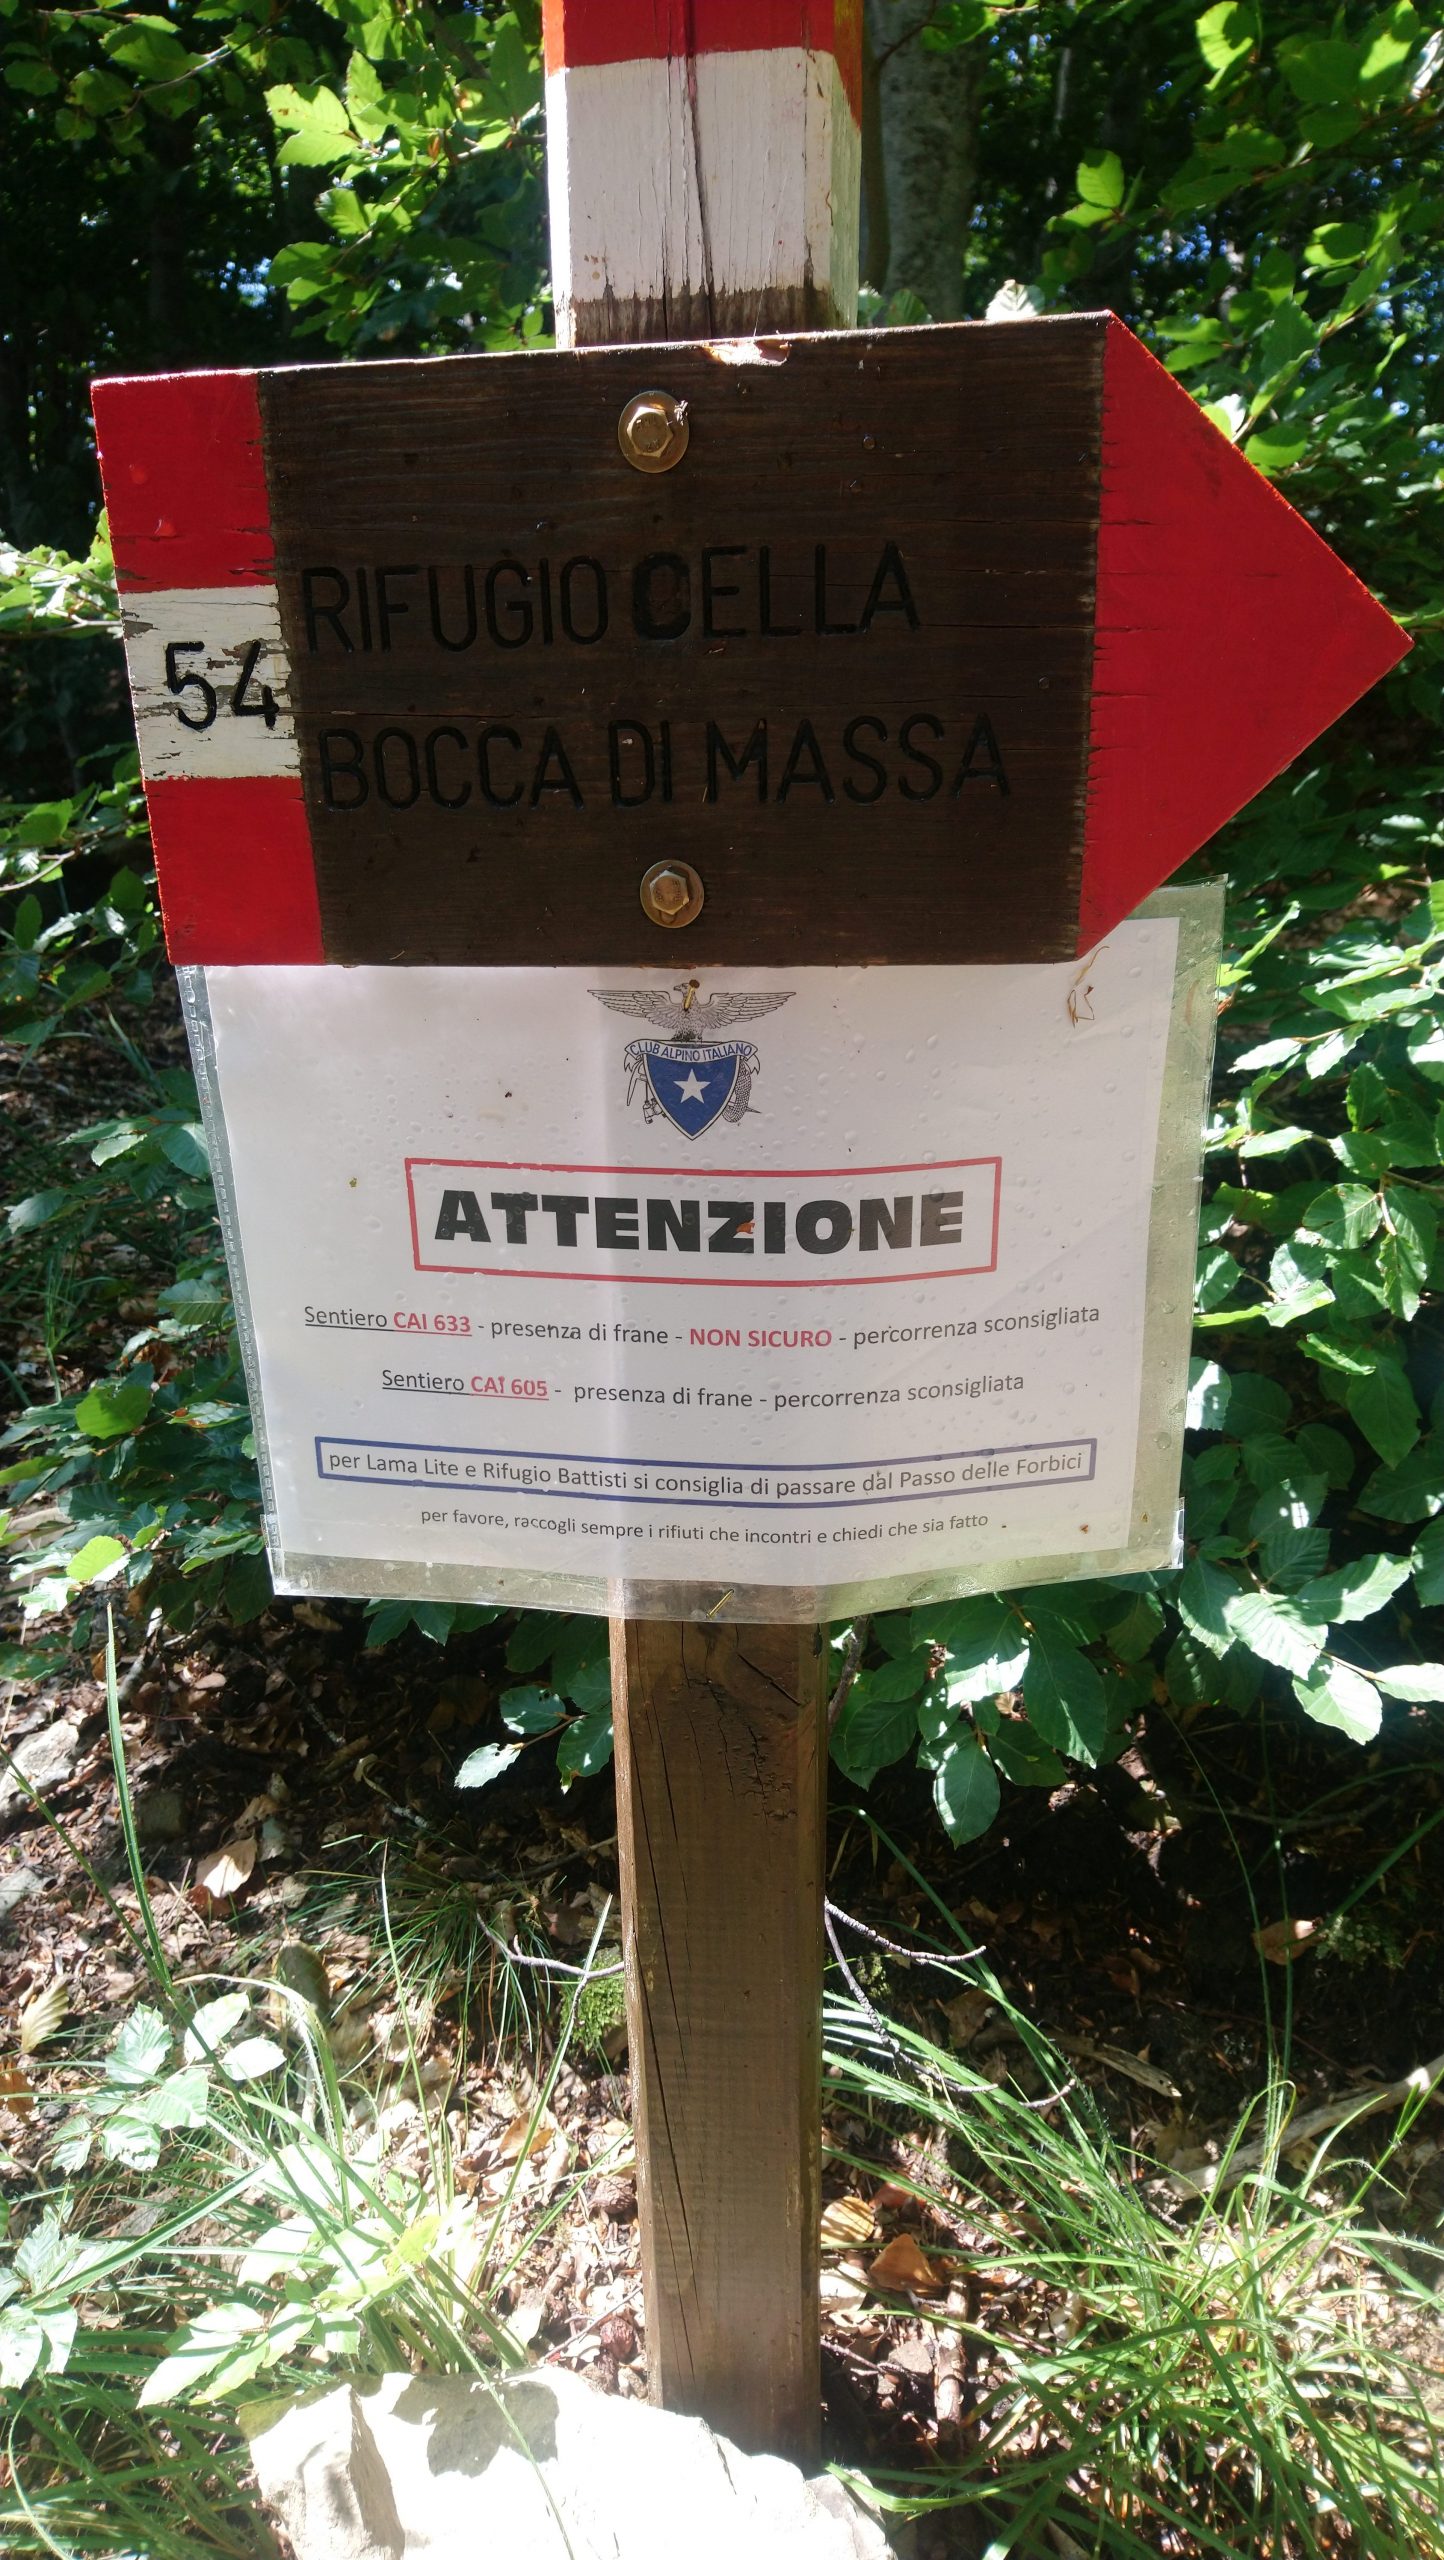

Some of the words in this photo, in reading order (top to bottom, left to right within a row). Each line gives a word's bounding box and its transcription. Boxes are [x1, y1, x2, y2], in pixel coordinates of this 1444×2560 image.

[303, 556, 609, 653] RIFUGIO
[633, 541, 920, 640] CELLA
[166, 641, 279, 731] 54
[320, 726, 584, 811] BOCCA
[608, 719, 673, 808] DI
[707, 712, 1010, 804] MASSA
[629, 1041, 660, 1056] CLUB
[661, 1046, 700, 1061] ALPINO
[703, 1042, 752, 1061] ITALIANO
[435, 1190, 964, 1254] ATTENZIONE
[305, 1306, 387, 1328] Sentiero
[393, 1311, 427, 1330] CAI
[433, 1314, 471, 1333] 633
[491, 1320, 582, 1340] presenza
[589, 1322, 607, 1342] di
[614, 1324, 668, 1344] frane
[690, 1328, 741, 1347] NON
[748, 1328, 832, 1348] SICURO
[854, 1320, 977, 1350] percorrenza
[984, 1306, 1100, 1333] sconsigliata
[382, 1370, 465, 1393] Sentiero
[471, 1376, 505, 1394] CAI
[511, 1378, 548, 1397] 605
[574, 1385, 665, 1404] presenza
[673, 1387, 690, 1405] di
[697, 1388, 752, 1408] frane
[774, 1390, 900, 1412] percorrenza
[907, 1374, 1024, 1399] sconsigliata
[329, 1452, 360, 1471] per
[367, 1454, 417, 1473] Lama
[425, 1458, 459, 1476] Lite
[465, 1464, 476, 1478] e
[484, 1461, 551, 1485] Rifugio
[558, 1467, 626, 1488] Battisti
[634, 1472, 648, 1490] si
[655, 1476, 743, 1497] consiglia
[750, 1477, 769, 1496] di
[776, 1478, 856, 1499] passare
[862, 1473, 892, 1492] dal
[900, 1468, 955, 1488] Passo
[962, 1462, 1009, 1482] delle
[1016, 1453, 1082, 1475] Forbici
[421, 1509, 447, 1525] per
[453, 1509, 508, 1529] favore,
[514, 1515, 576, 1535] raccogli
[581, 1521, 643, 1540] sempre
[649, 1524, 653, 1537] i
[658, 1524, 703, 1540] rifiuti
[709, 1527, 740, 1542] che
[745, 1527, 811, 1544] incontri
[817, 1532, 827, 1543] e
[832, 1524, 883, 1543] chiedi
[888, 1520, 918, 1537] che
[923, 1517, 945, 1534] sia
[949, 1513, 988, 1531] fatto
